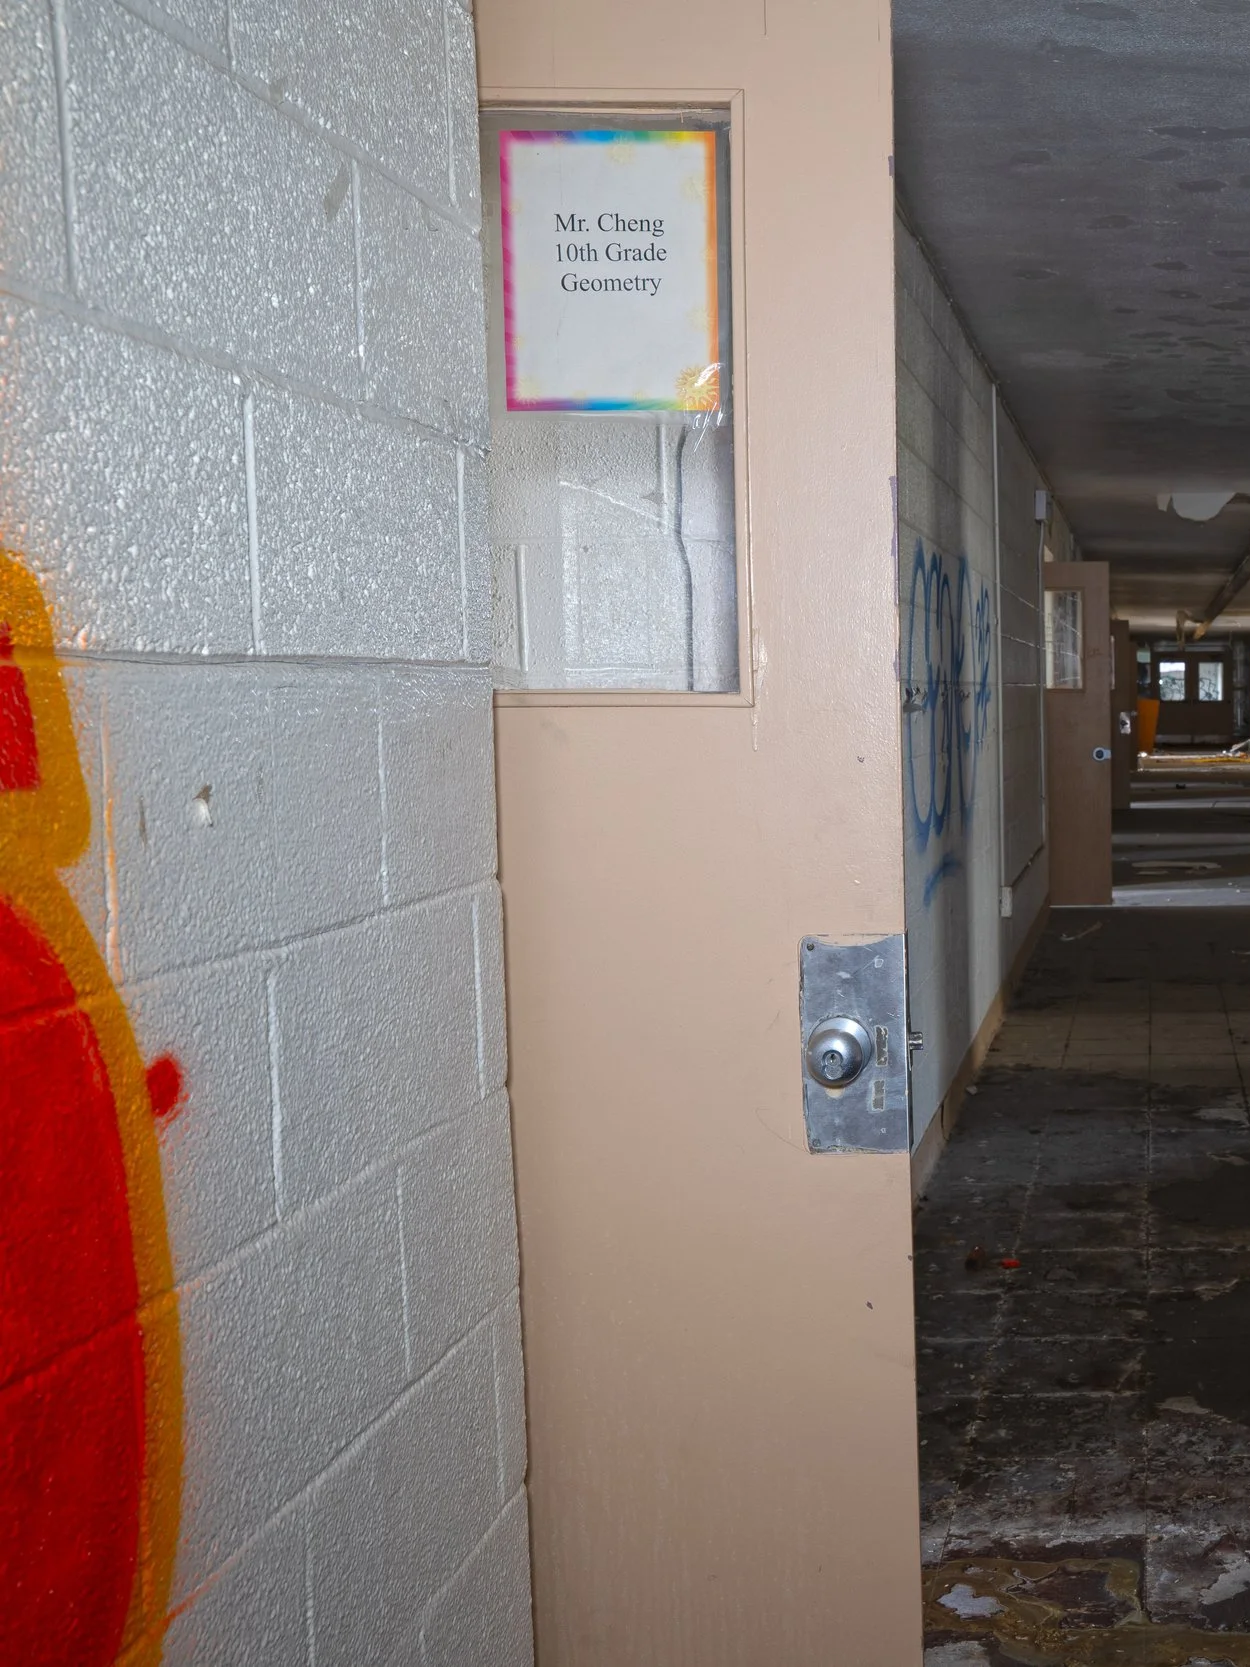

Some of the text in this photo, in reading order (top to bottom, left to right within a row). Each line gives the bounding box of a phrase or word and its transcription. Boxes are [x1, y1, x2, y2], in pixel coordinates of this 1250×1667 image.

[554, 212, 665, 237] Mr. Cheng
[555, 243, 668, 263] 10th Grade
[560, 272, 662, 296] Geometry
